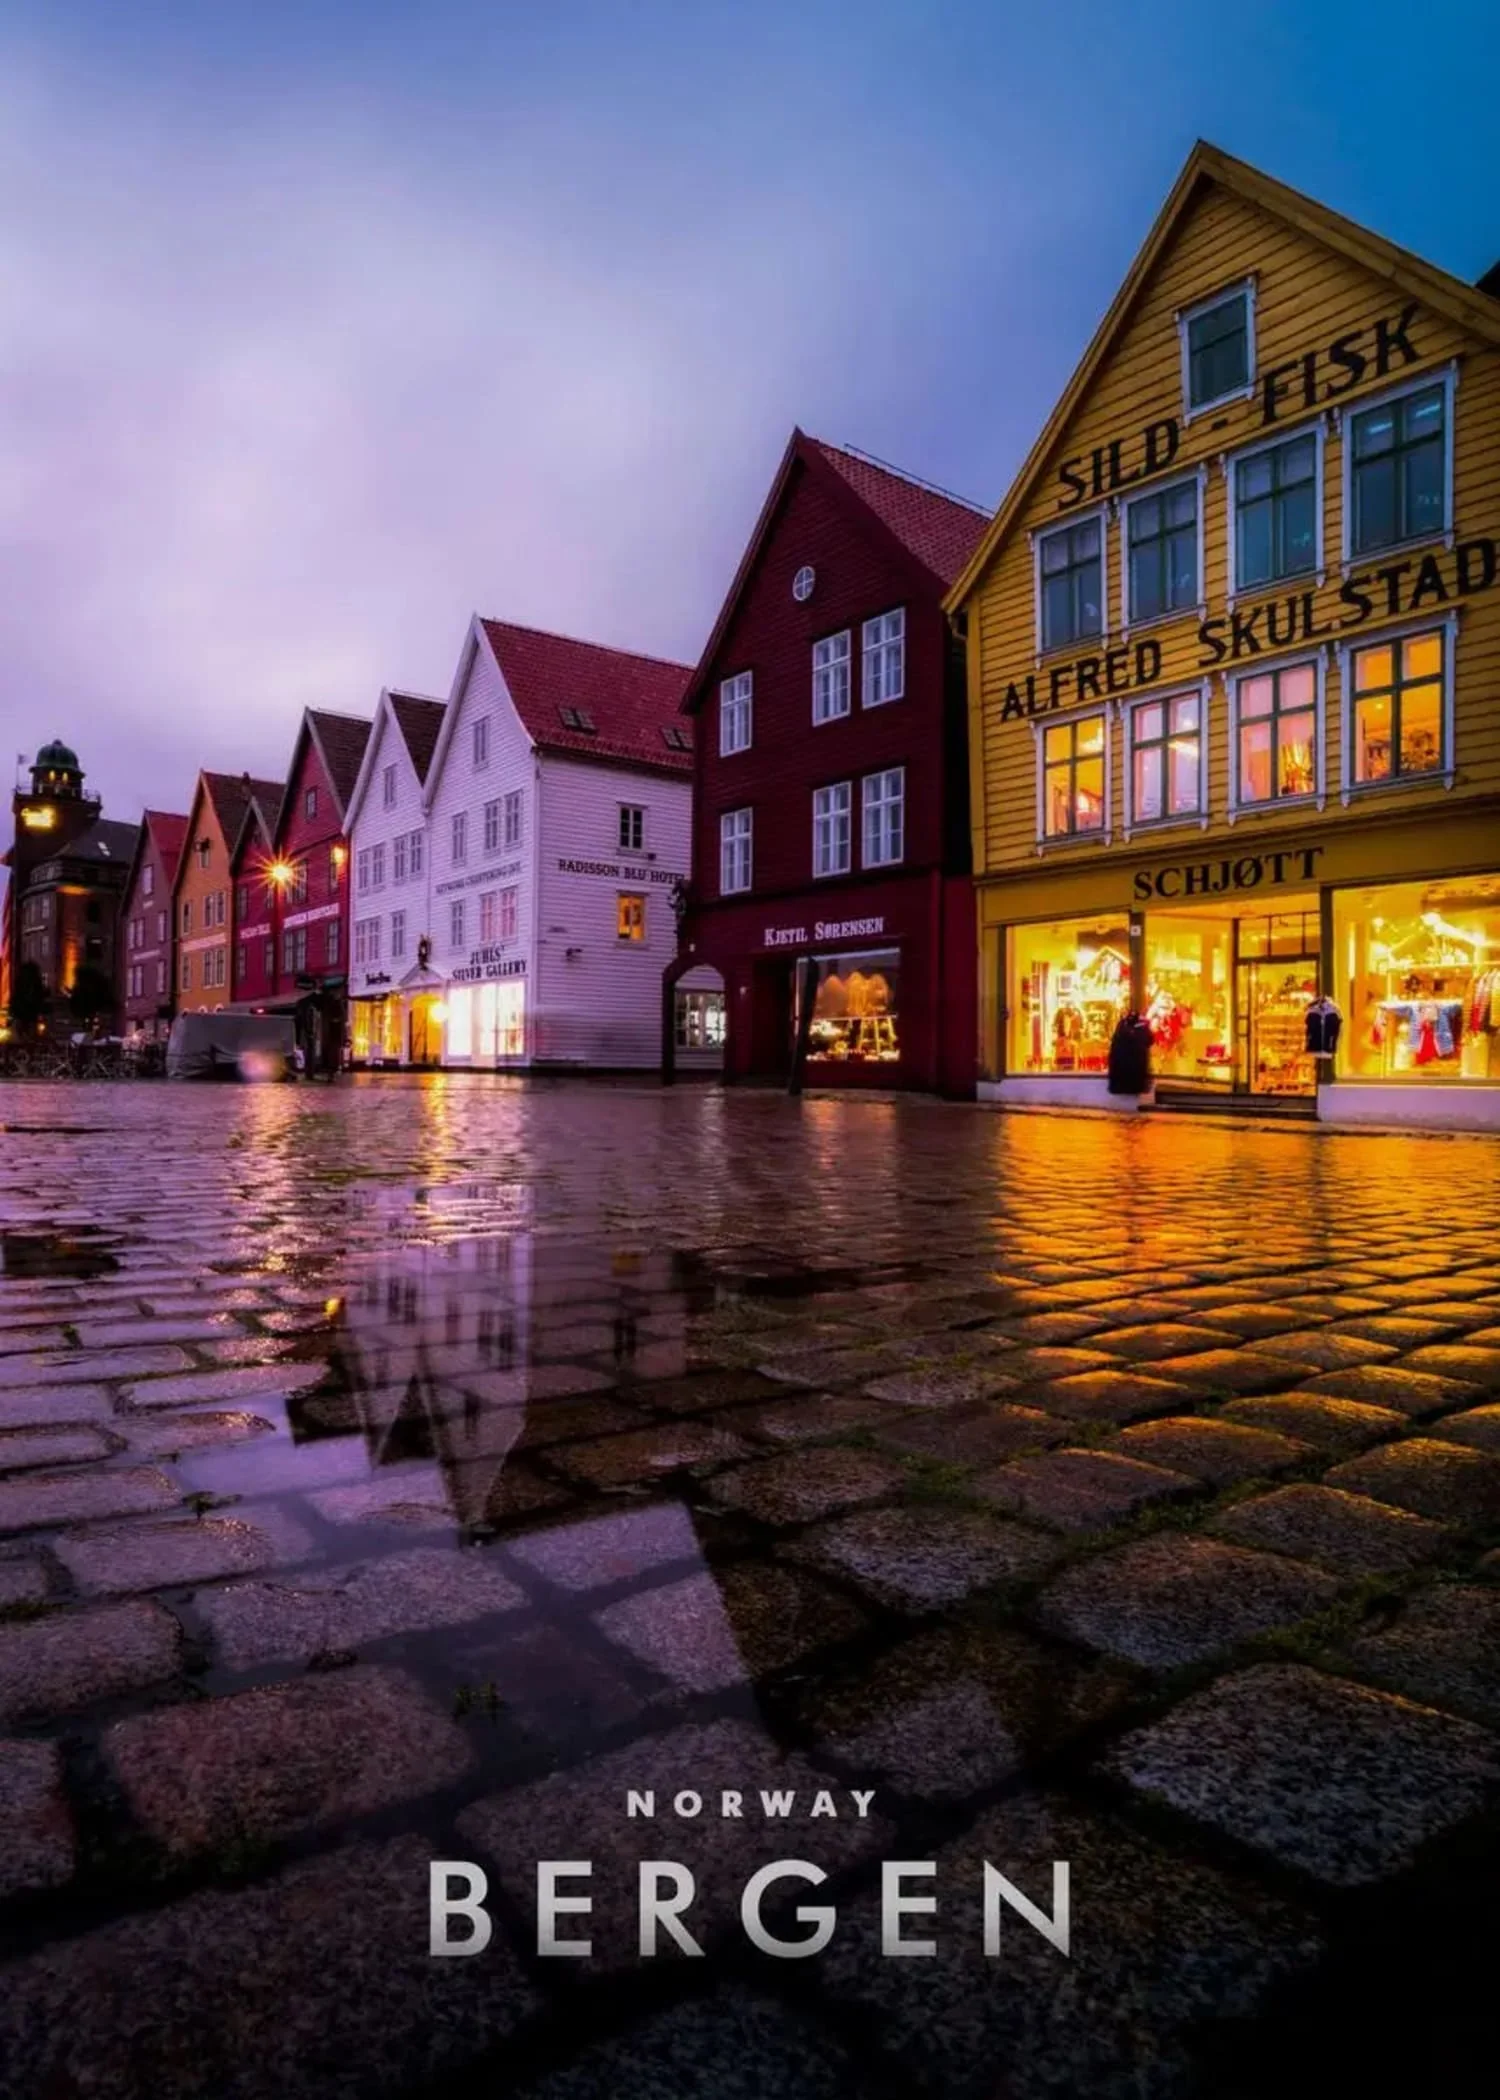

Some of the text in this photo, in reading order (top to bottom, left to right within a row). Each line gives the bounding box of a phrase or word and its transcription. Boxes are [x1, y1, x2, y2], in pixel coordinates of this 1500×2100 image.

[1058, 418, 1179, 509] SILD
[1262, 302, 1420, 426] FISK
[1001, 538, 1496, 722] ALFRED SKULSTAD
[559, 859, 619, 877] RADISSON
[624, 867, 646, 880] BLU
[1134, 847, 1324, 901] SCHJØTT
